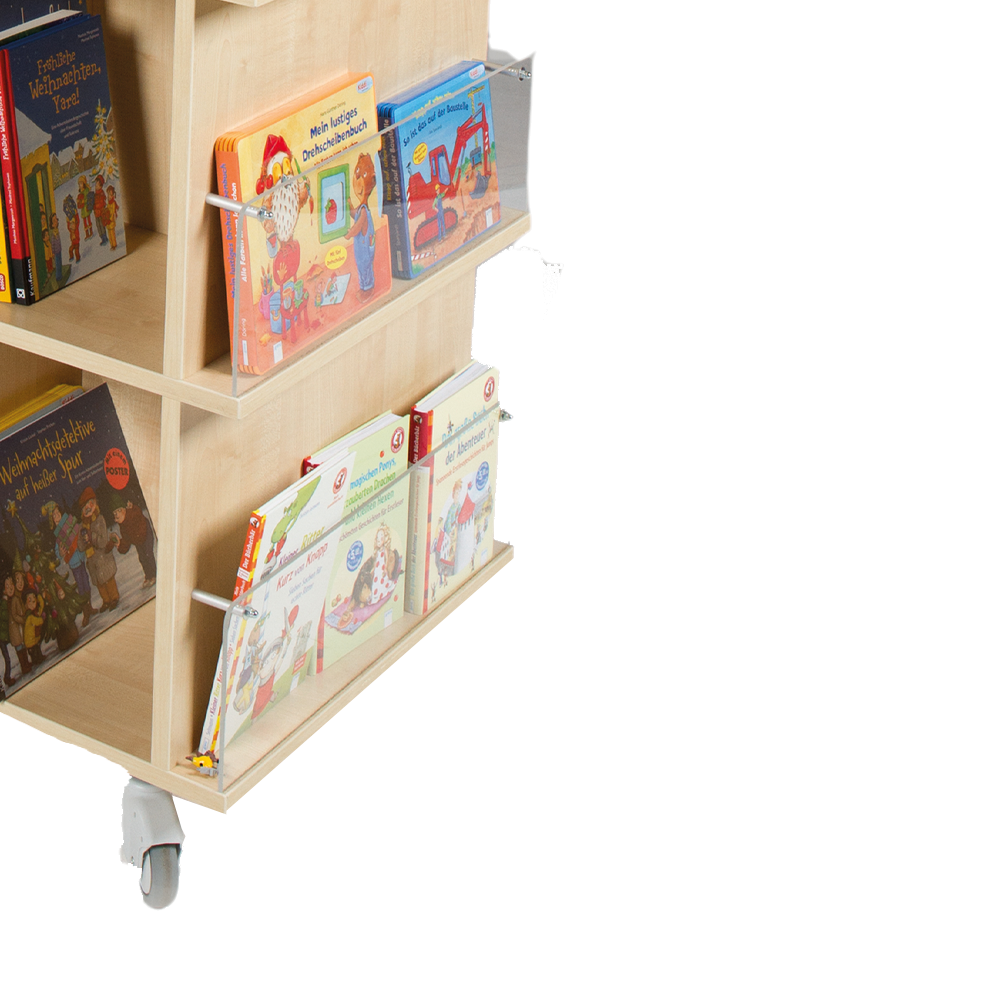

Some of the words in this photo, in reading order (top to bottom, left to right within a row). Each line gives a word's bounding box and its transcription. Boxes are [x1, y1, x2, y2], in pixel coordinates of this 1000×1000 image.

[36, 50, 76, 76] Fröhliche
[28, 61, 101, 100] Weihnachten,
[52, 87, 80, 114] Yara!
[310, 121, 329, 140] Mein
[330, 108, 358, 129] lustiges
[403, 137, 410, 147] So
[410, 129, 418, 139] ist
[418, 121, 427, 132] das
[428, 111, 436, 124] auf
[438, 108, 446, 118] der
[446, 102, 469, 114] Baustelle
[303, 118, 368, 162] Drehscheibenbuch
[445, 451, 456, 466] der
[457, 428, 487, 457] Abenteuer
[15, 477, 30, 501] auf
[30, 468, 58, 494] heißer
[58, 451, 83, 484] Spur
[106, 467, 129, 476] POSTER
[350, 467, 379, 491] magischen
[379, 458, 397, 474] Ponys,
[374, 472, 396, 492] Drachen
[377, 490, 395, 506] Hexen
[359, 512, 381, 531] Geschichten
[245, 529, 256, 559] Bücherbär
[276, 571, 294, 592] Kurz
